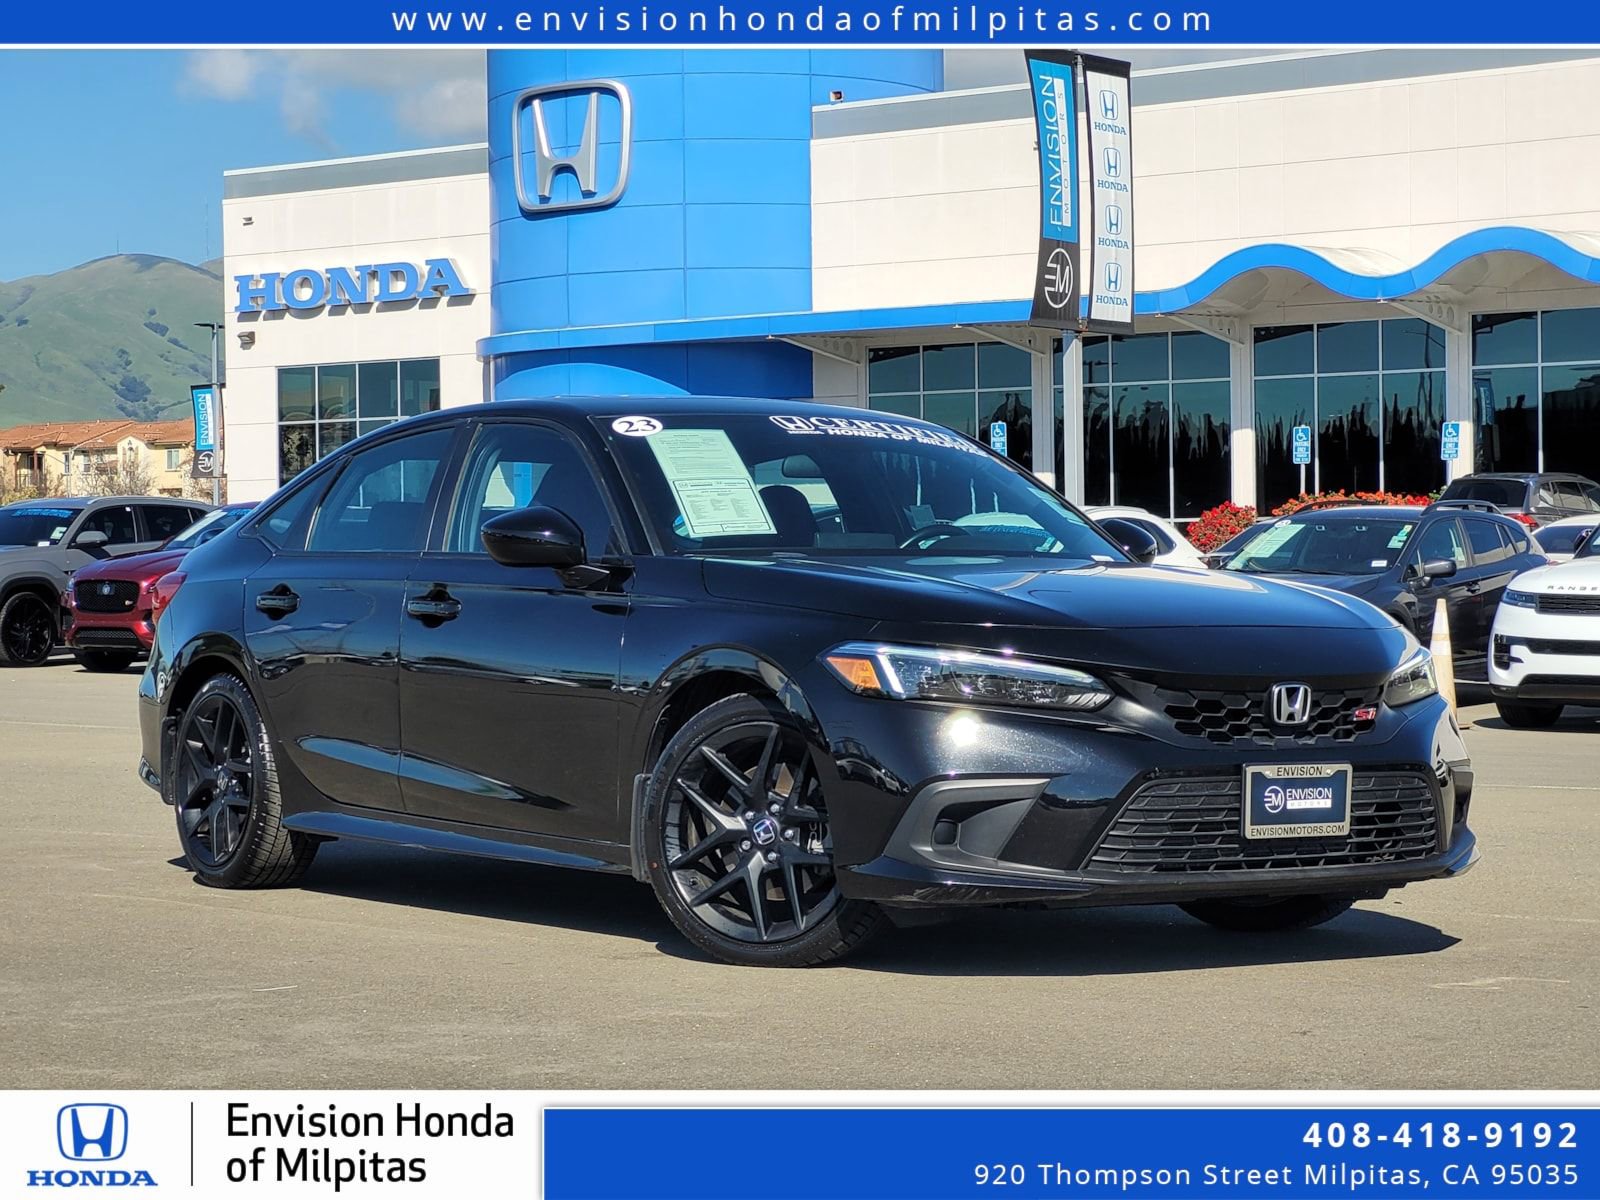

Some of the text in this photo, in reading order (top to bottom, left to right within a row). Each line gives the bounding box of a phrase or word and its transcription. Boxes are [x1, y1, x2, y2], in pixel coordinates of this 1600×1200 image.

[1094, 121, 1127, 136] HONDA
[1039, 75, 1063, 226] ENVISION
[1057, 92, 1070, 214] MOTORS
[1097, 179, 1129, 193] HONDA
[1098, 237, 1130, 250] HONDA
[234, 257, 470, 313] HONDA
[1096, 294, 1129, 307] HONDA
[197, 393, 209, 446] ENVISION
[618, 418, 657, 433] 23
[827, 428, 890, 439] HONDA
[1276, 766, 1323, 776] ENVISION
[1286, 787, 1332, 800] ENVISION
[1250, 824, 1345, 837] ENVISIONMOTORS.COM
